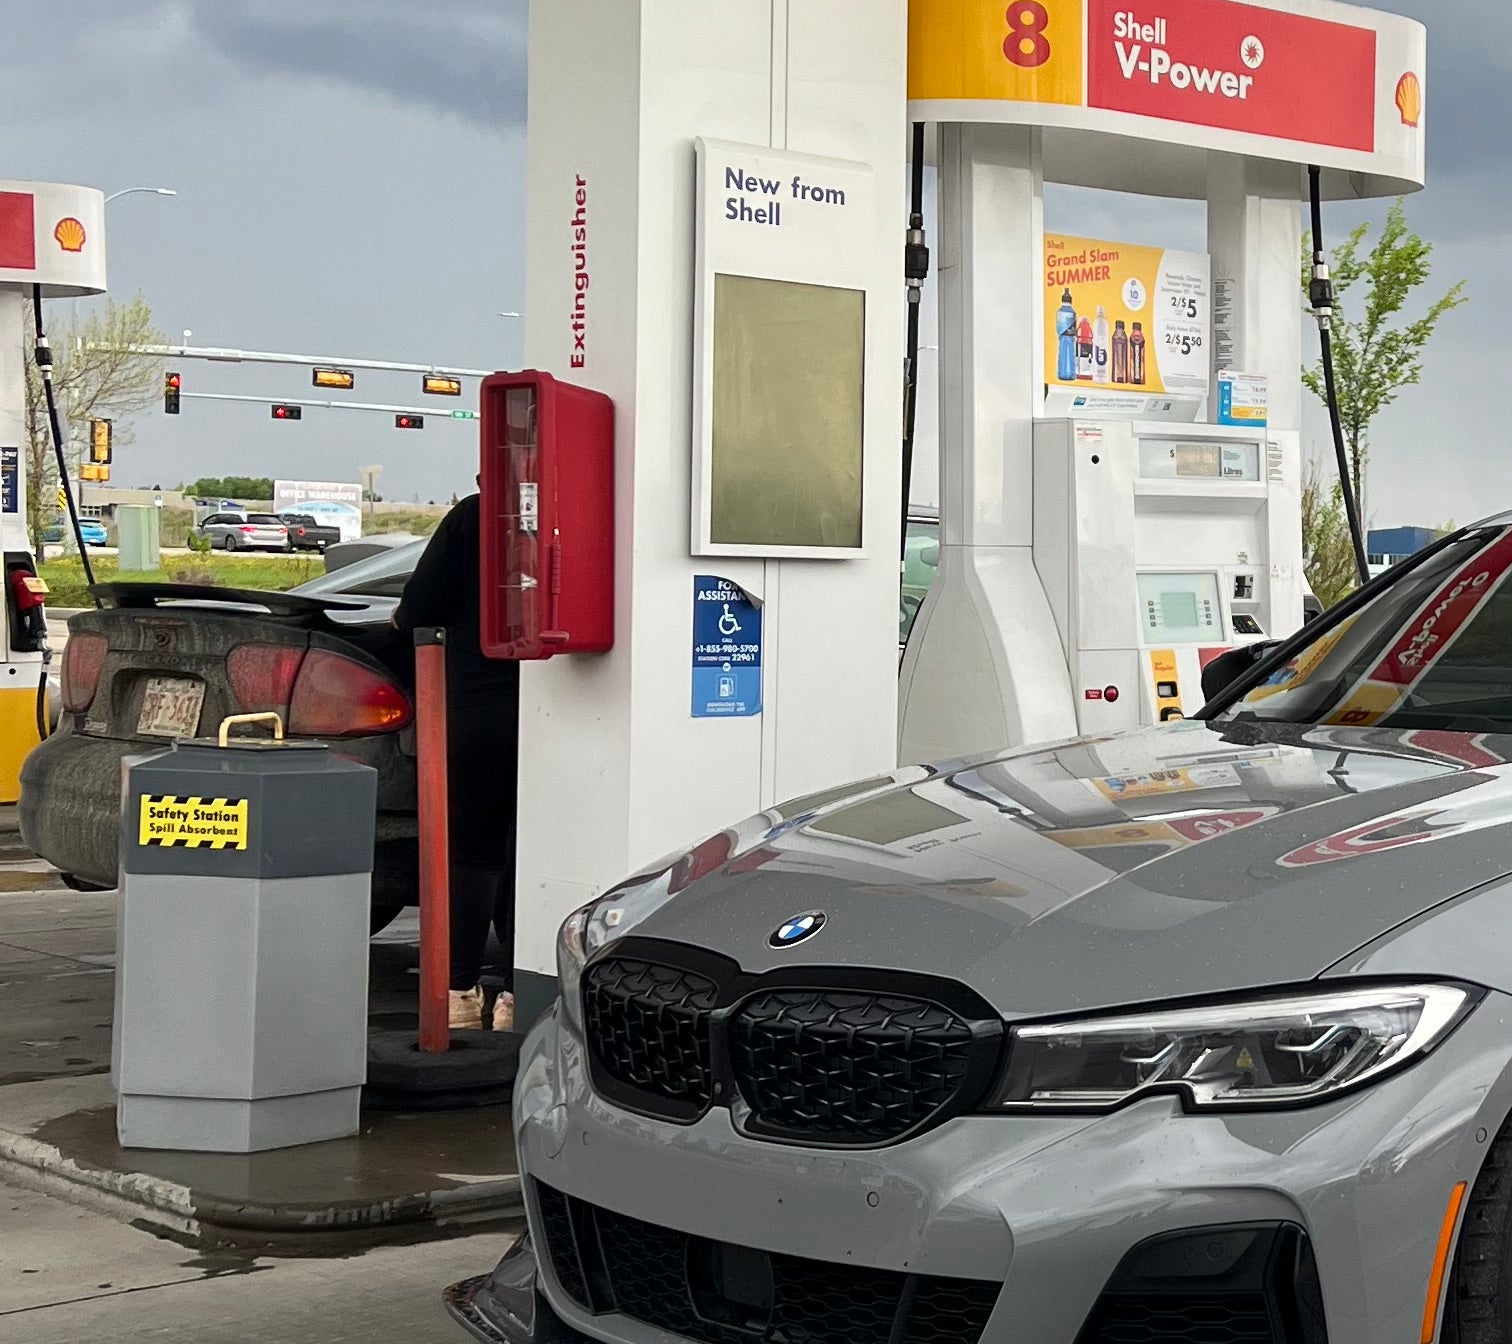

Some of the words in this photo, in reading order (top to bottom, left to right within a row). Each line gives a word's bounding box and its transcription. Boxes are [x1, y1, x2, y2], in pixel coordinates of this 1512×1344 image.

[1113, 10, 1167, 45] Shell
[1113, 40, 1254, 100] V-Power
[725, 166, 781, 195] New
[791, 176, 846, 205] from
[725, 197, 781, 226] Shell
[570, 174, 589, 369] Extinguisher
[1046, 249, 1087, 268] Grand
[1089, 248, 1120, 263] Slam
[1046, 265, 1111, 287] SUMMER
[149, 806, 189, 823] Safety
[193, 808, 239, 823] Station
[149, 822, 175, 834] Spill
[178, 823, 238, 836] Absorbent
